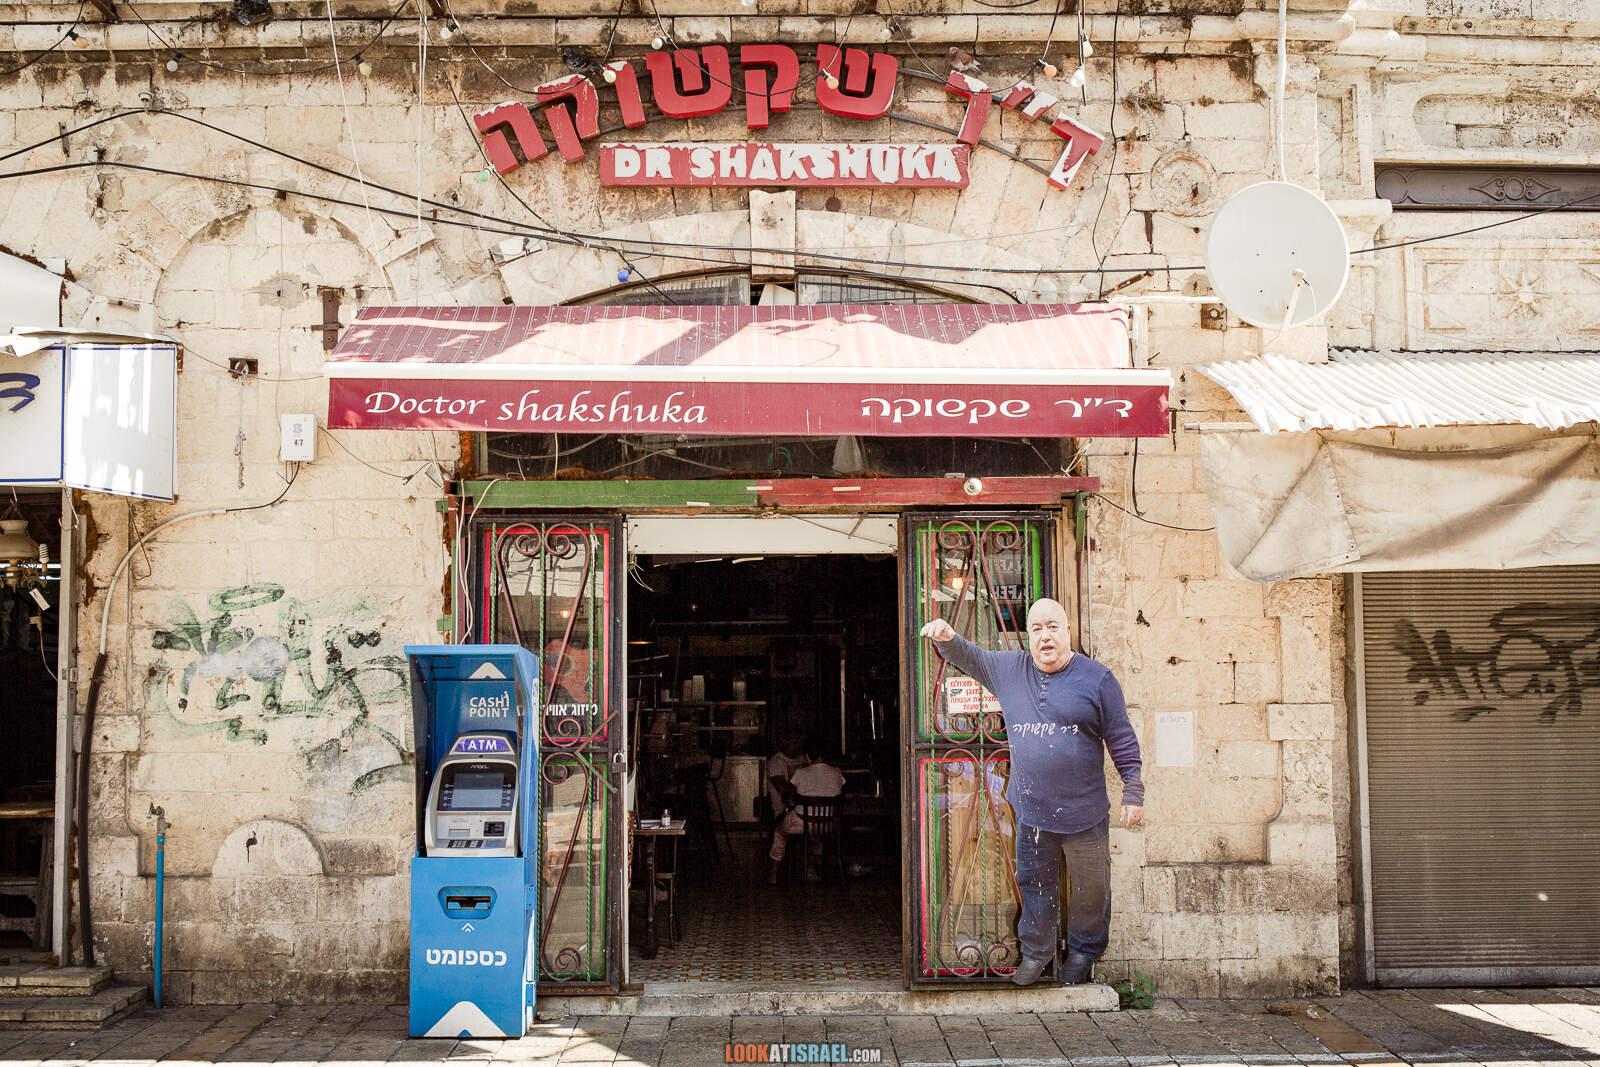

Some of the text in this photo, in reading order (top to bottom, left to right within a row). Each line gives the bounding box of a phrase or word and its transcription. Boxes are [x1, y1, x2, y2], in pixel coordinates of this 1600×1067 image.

[473, 43, 898, 175] שקשוקה
[613, 144, 962, 183] DR SHAKSHUKA
[364, 389, 708, 424] Doctor shakshuka
[861, 397, 1030, 425] שקשוקה
[469, 696, 505, 707] CASH
[469, 707, 510, 718] POINT
[1012, 722, 1056, 738] שקשוקה
[467, 739, 498, 750] ATM
[426, 949, 508, 967] כספומט
